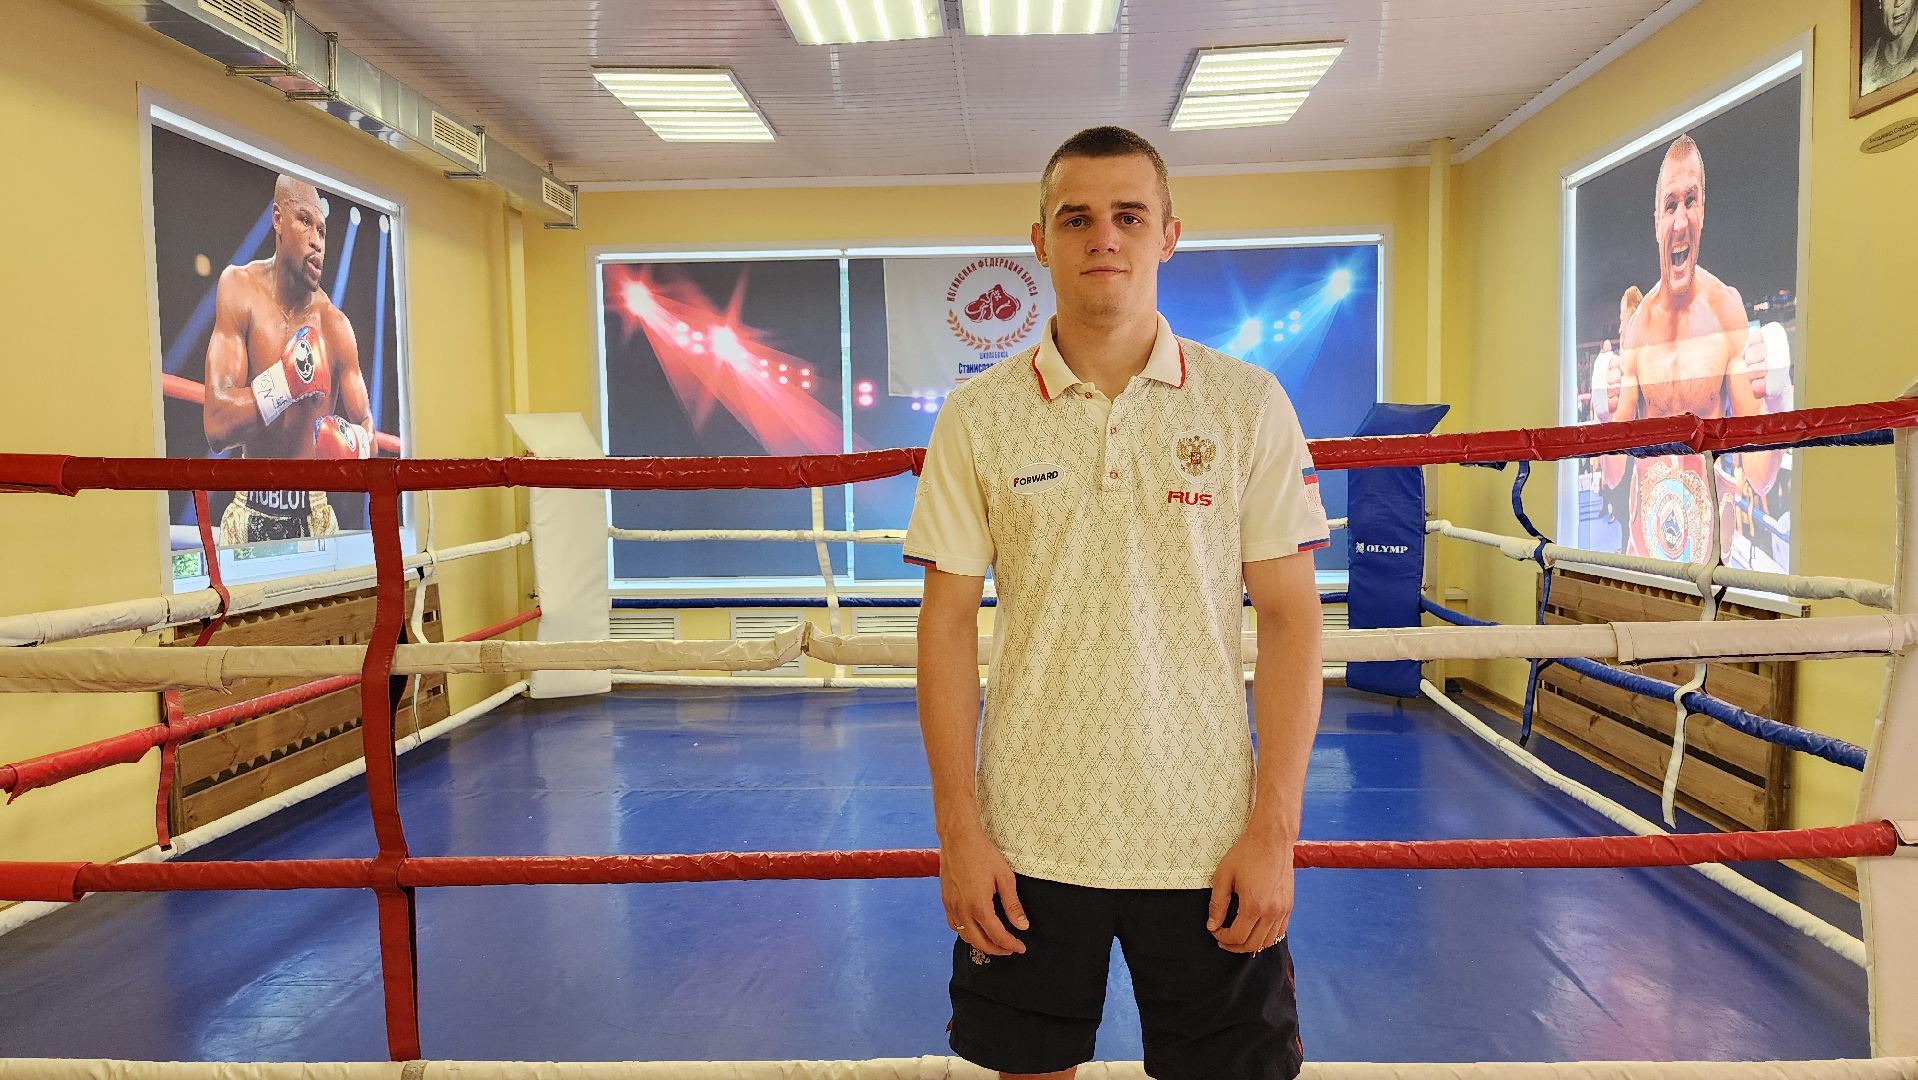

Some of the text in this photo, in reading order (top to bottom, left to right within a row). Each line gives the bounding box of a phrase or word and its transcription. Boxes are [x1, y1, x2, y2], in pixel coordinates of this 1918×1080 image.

[978, 257, 1024, 275] ФЕДЕРАЦИЯ
[1020, 271, 1039, 297] БОКСА
[1013, 470, 1059, 488] FORWARD
[1167, 490, 1213, 507] RUS
[1366, 544, 1409, 555] OLYMP
